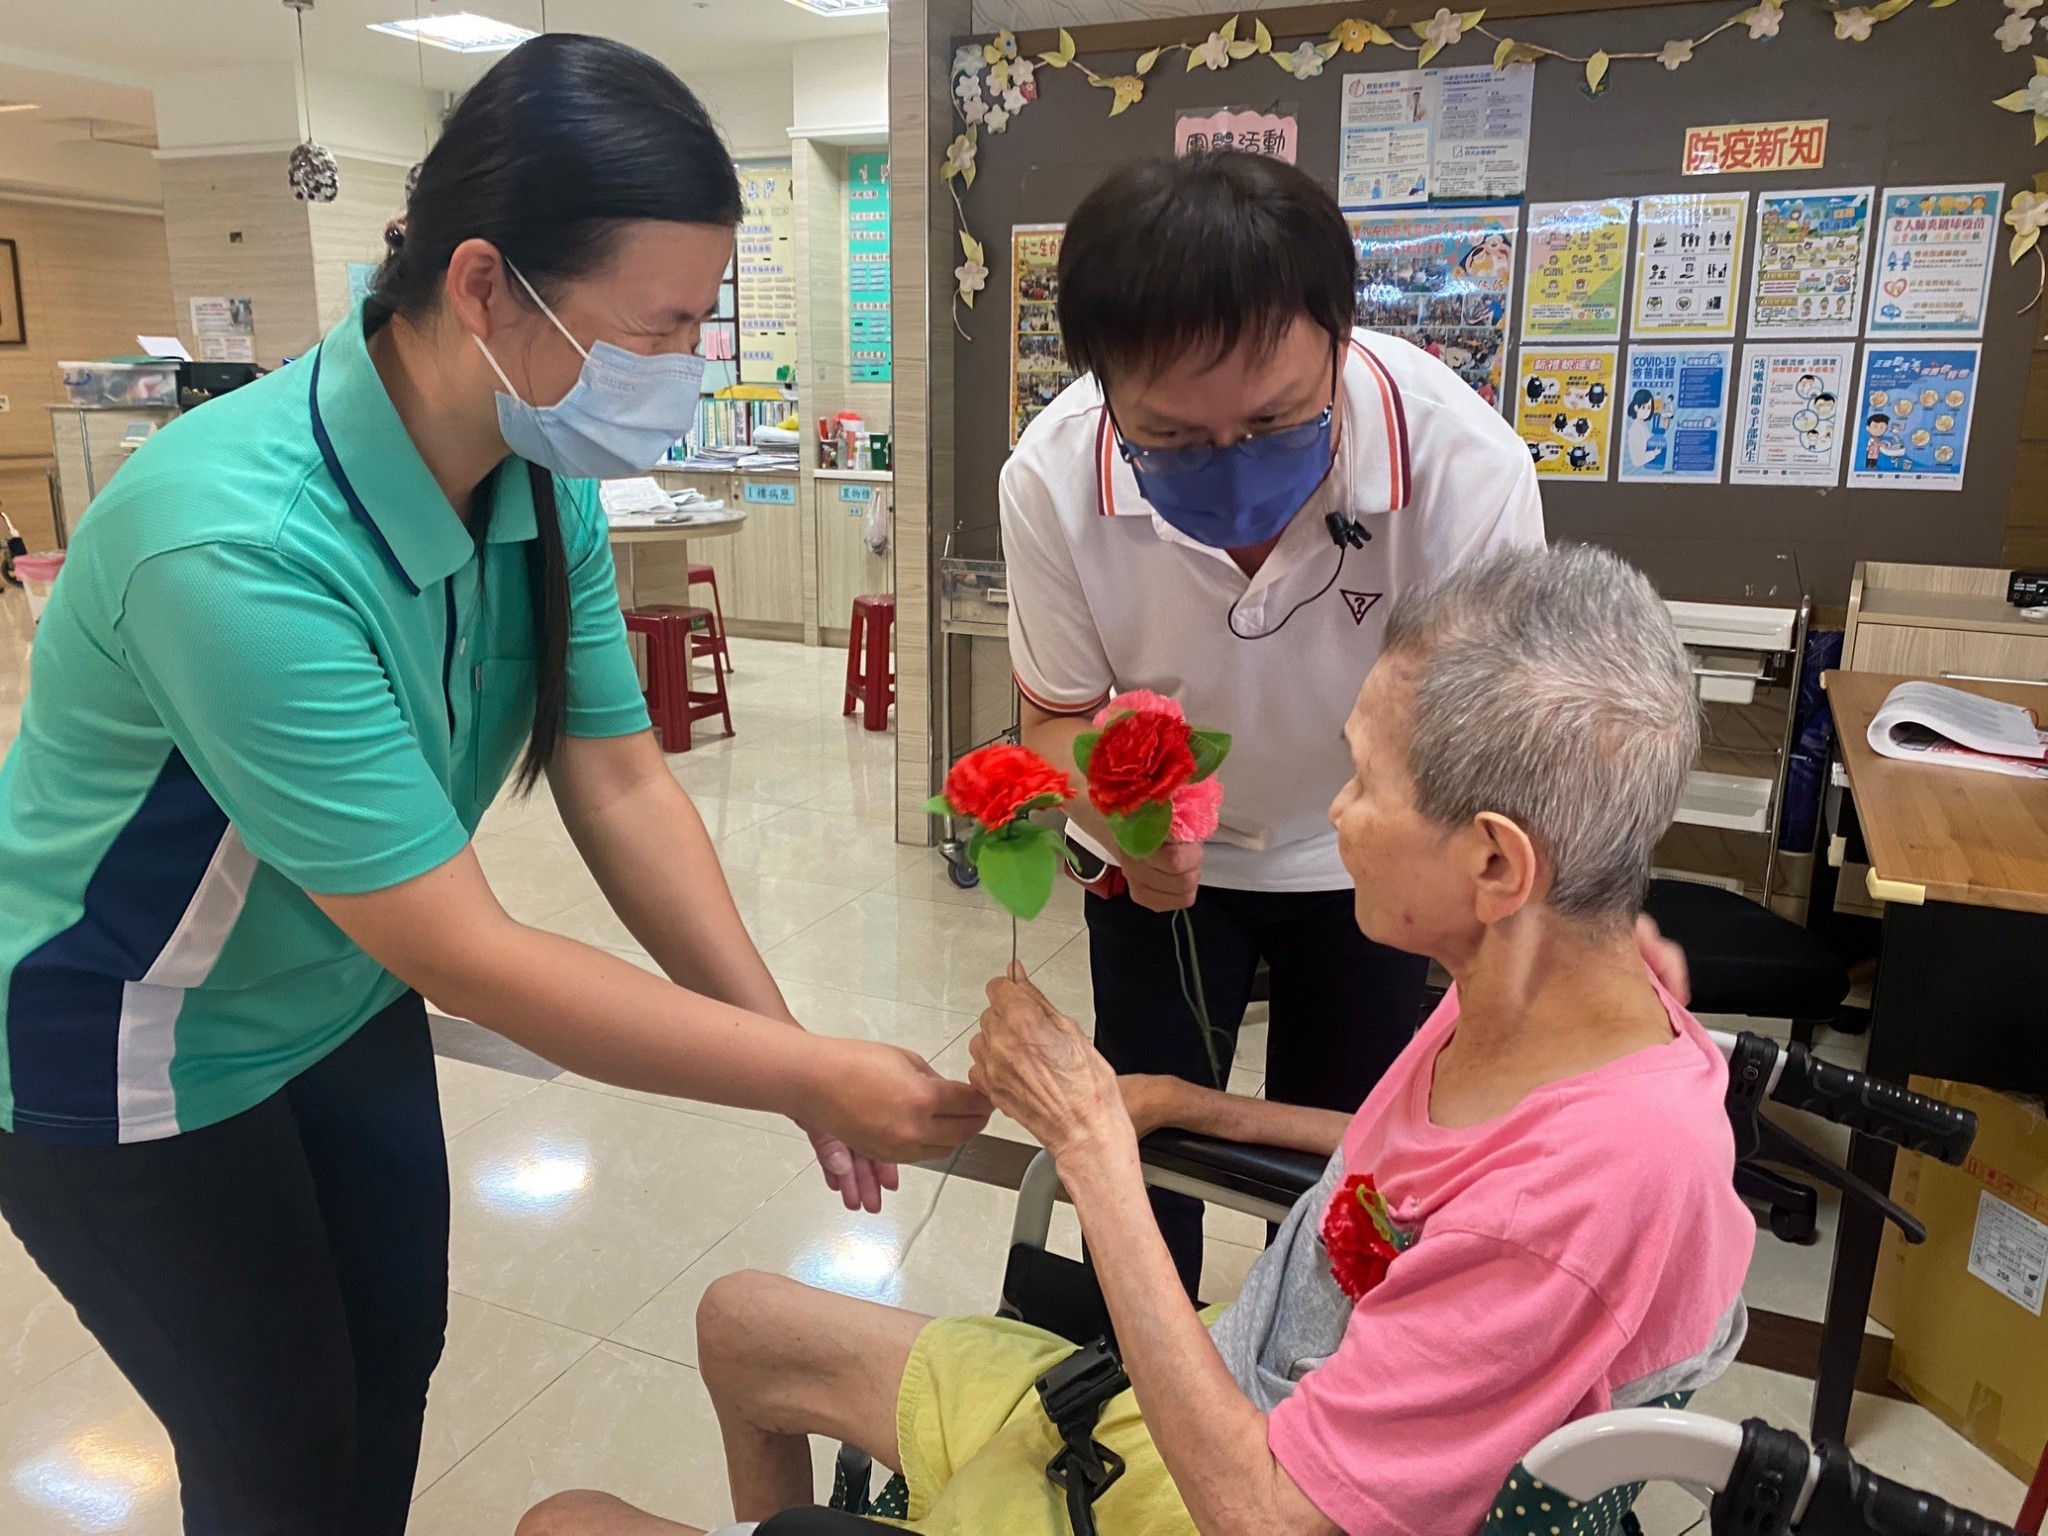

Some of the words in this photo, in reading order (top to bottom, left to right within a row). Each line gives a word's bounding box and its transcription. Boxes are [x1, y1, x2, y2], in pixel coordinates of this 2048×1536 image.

[1686, 125, 1824, 171] 防疫新知
[1633, 356, 1676, 367] COVID-19
[1632, 368, 1675, 379] 疫苗接種
